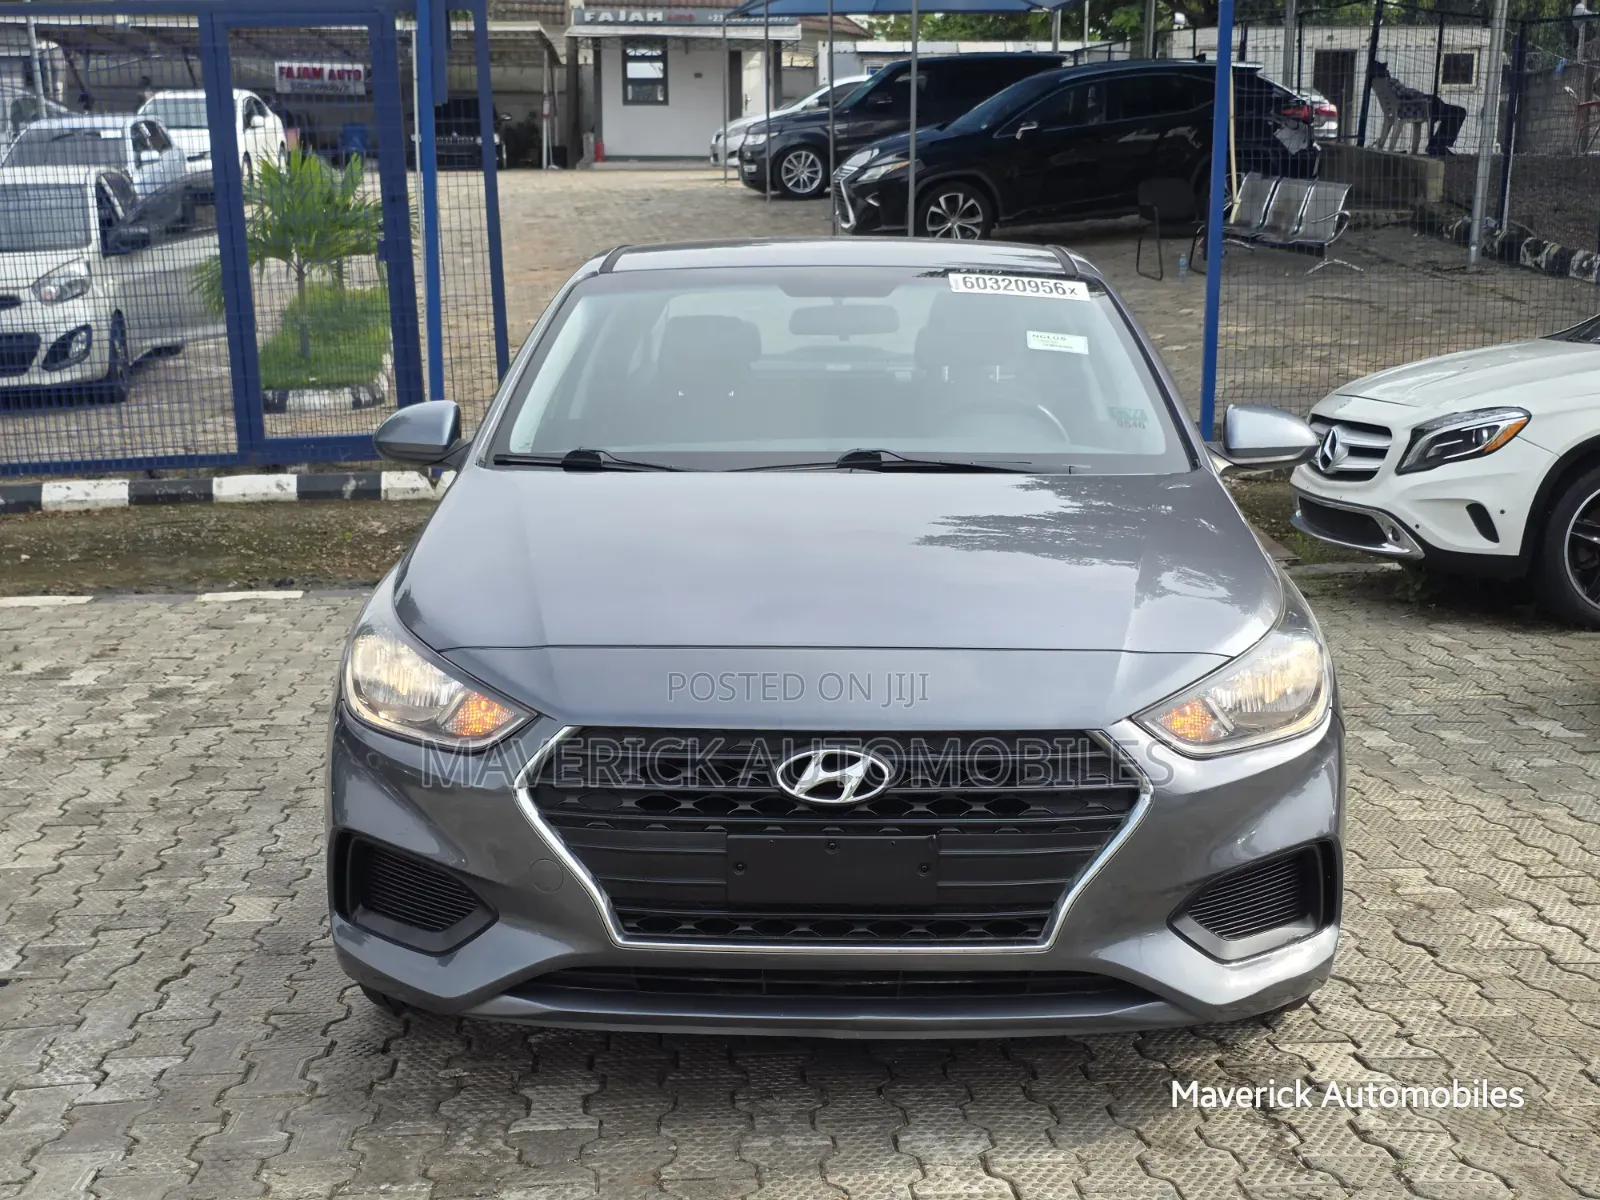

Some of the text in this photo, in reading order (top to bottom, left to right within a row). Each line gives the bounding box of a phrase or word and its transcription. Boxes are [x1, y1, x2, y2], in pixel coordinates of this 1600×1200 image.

[583, 10, 664, 22] FAJAM
[278, 66, 362, 81] FAJAM AUTO
